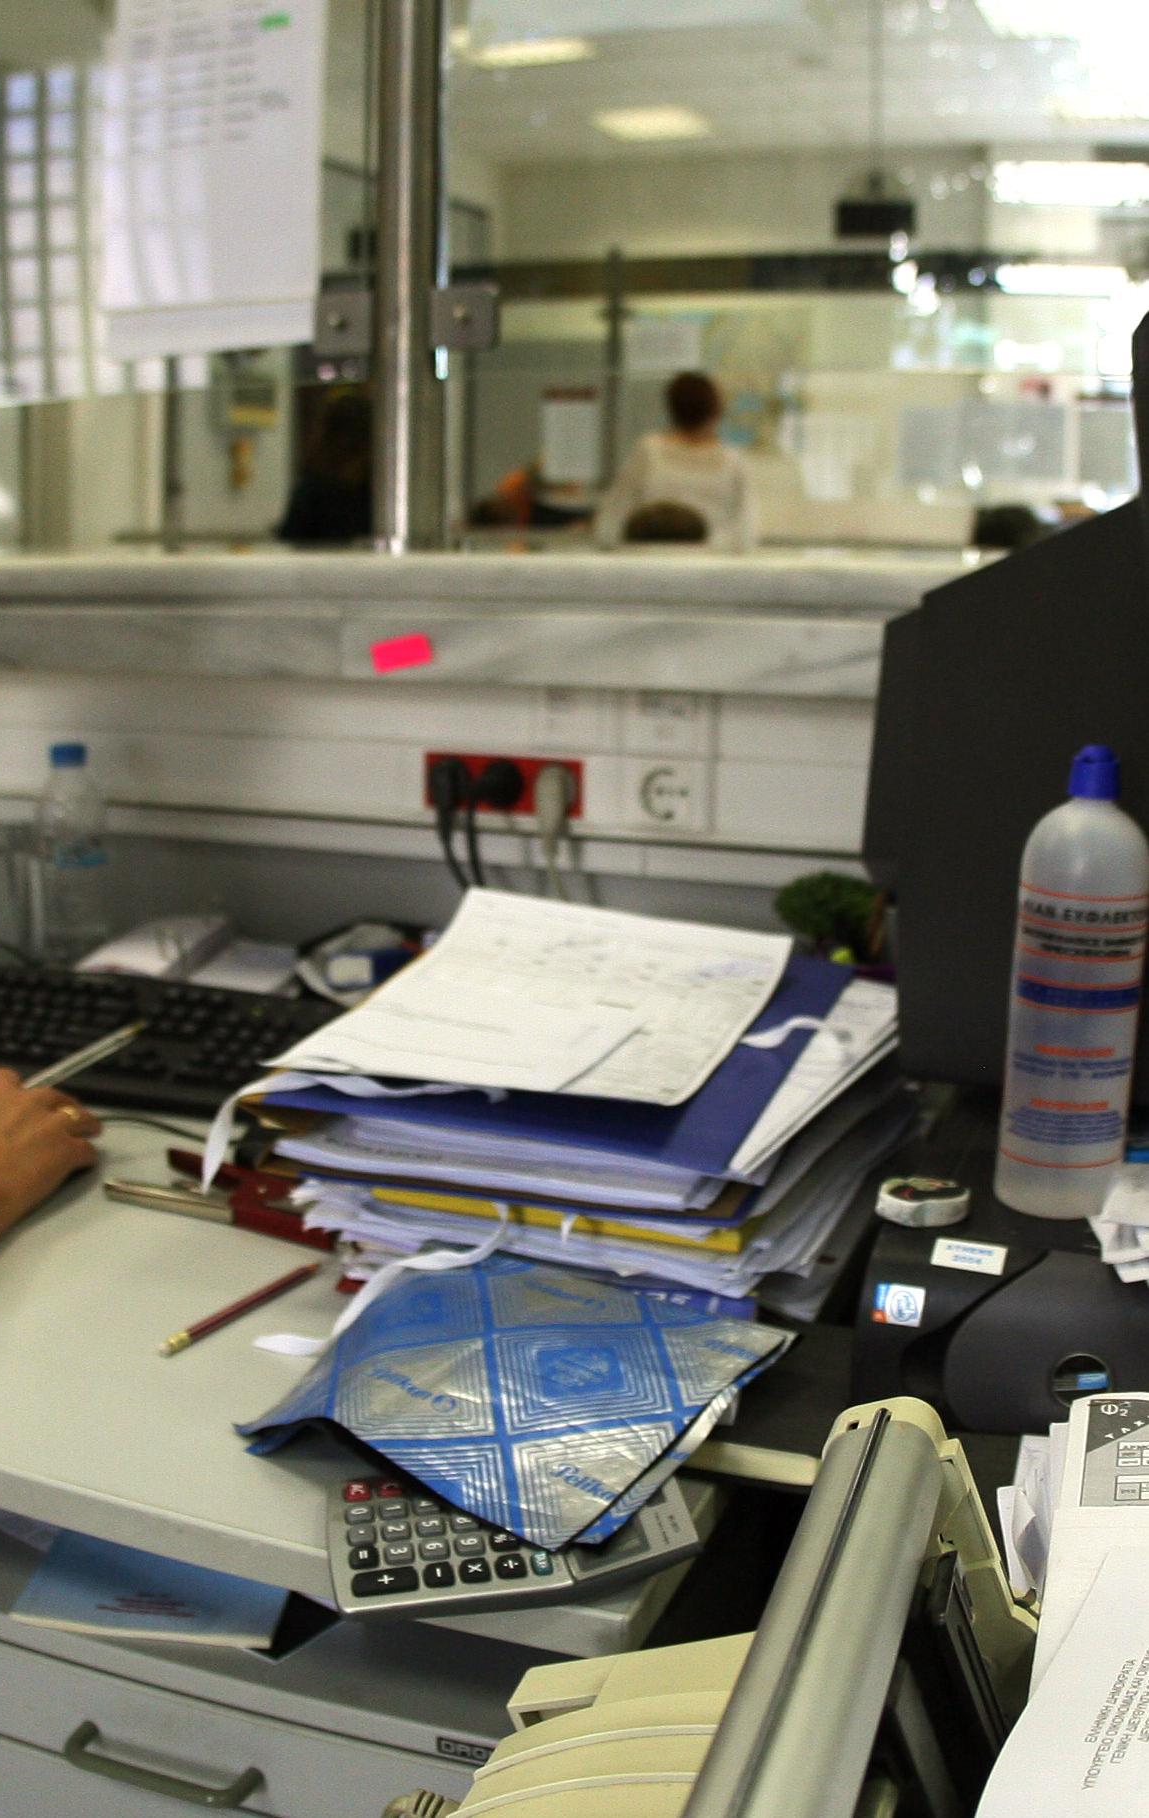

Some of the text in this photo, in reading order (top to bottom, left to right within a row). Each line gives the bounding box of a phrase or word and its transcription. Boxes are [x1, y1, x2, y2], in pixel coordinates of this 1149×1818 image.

[550, 1463, 619, 1502] Pelika
[387, 1524, 406, 1533] 2
[389, 1546, 408, 1555] 3
[440, 1740, 489, 1761] DRO
[1110, 1733, 1134, 1765] ΓΕΝΙΚΗ
[1081, 1737, 1113, 1791] ΥΠΟΥΡΓΕΙΟ
